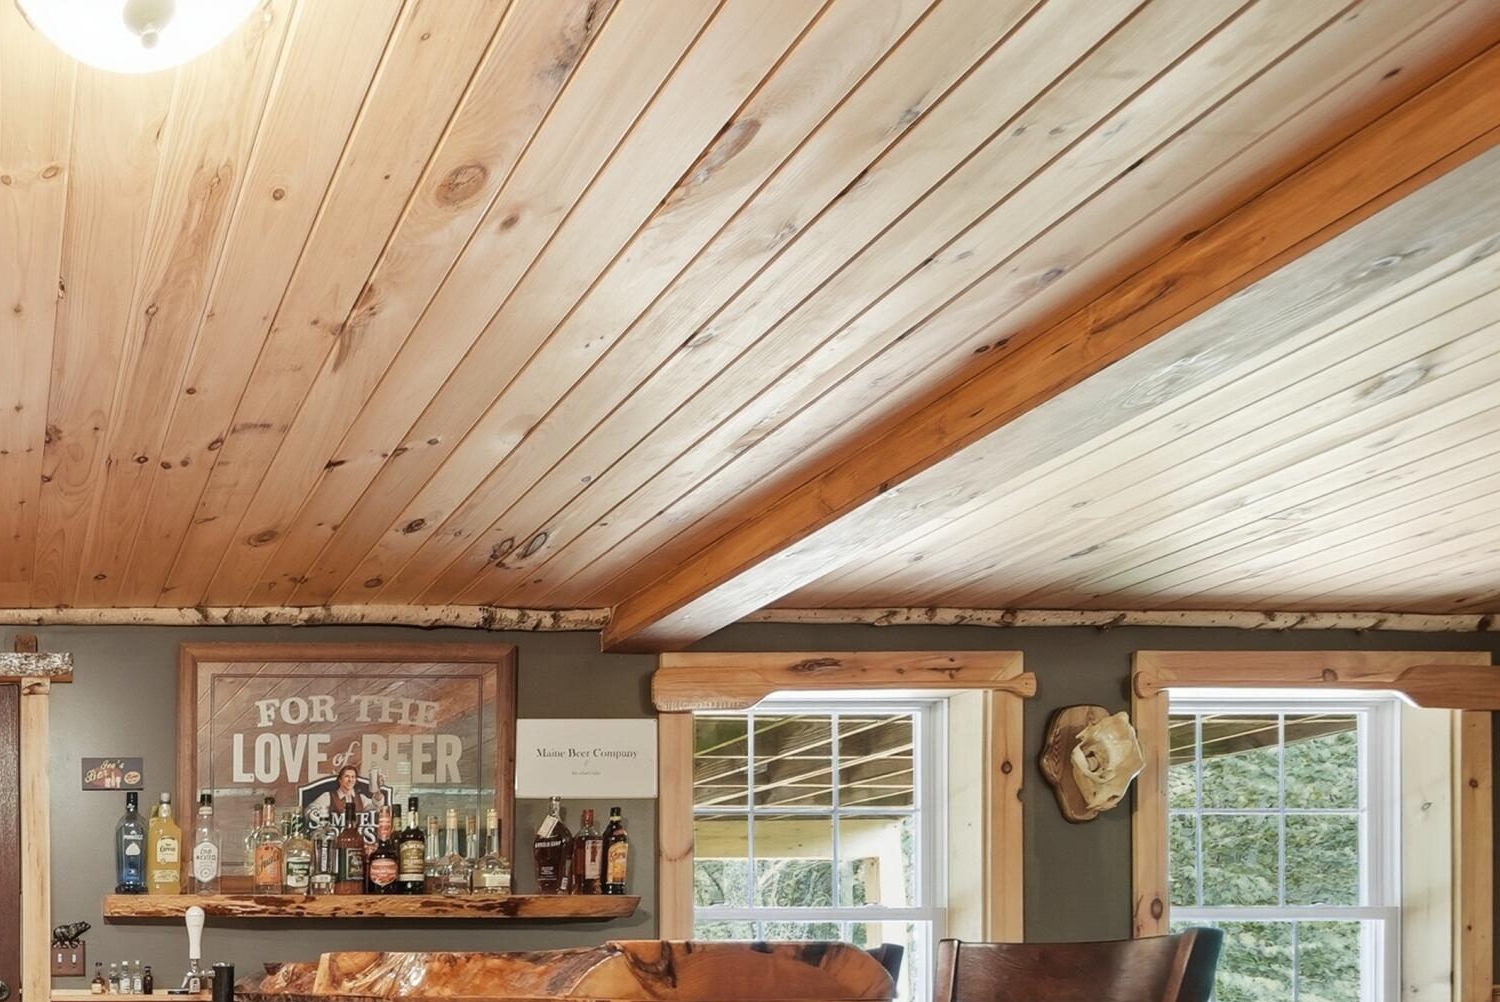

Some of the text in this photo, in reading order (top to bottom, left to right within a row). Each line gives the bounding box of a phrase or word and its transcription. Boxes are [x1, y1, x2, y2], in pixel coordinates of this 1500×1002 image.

[255, 695, 440, 729] FOR THE
[232, 733, 464, 784] LOVE of BEER
[536, 748, 637, 760] Maine Beer Company
[309, 809, 380, 829] SMEL
